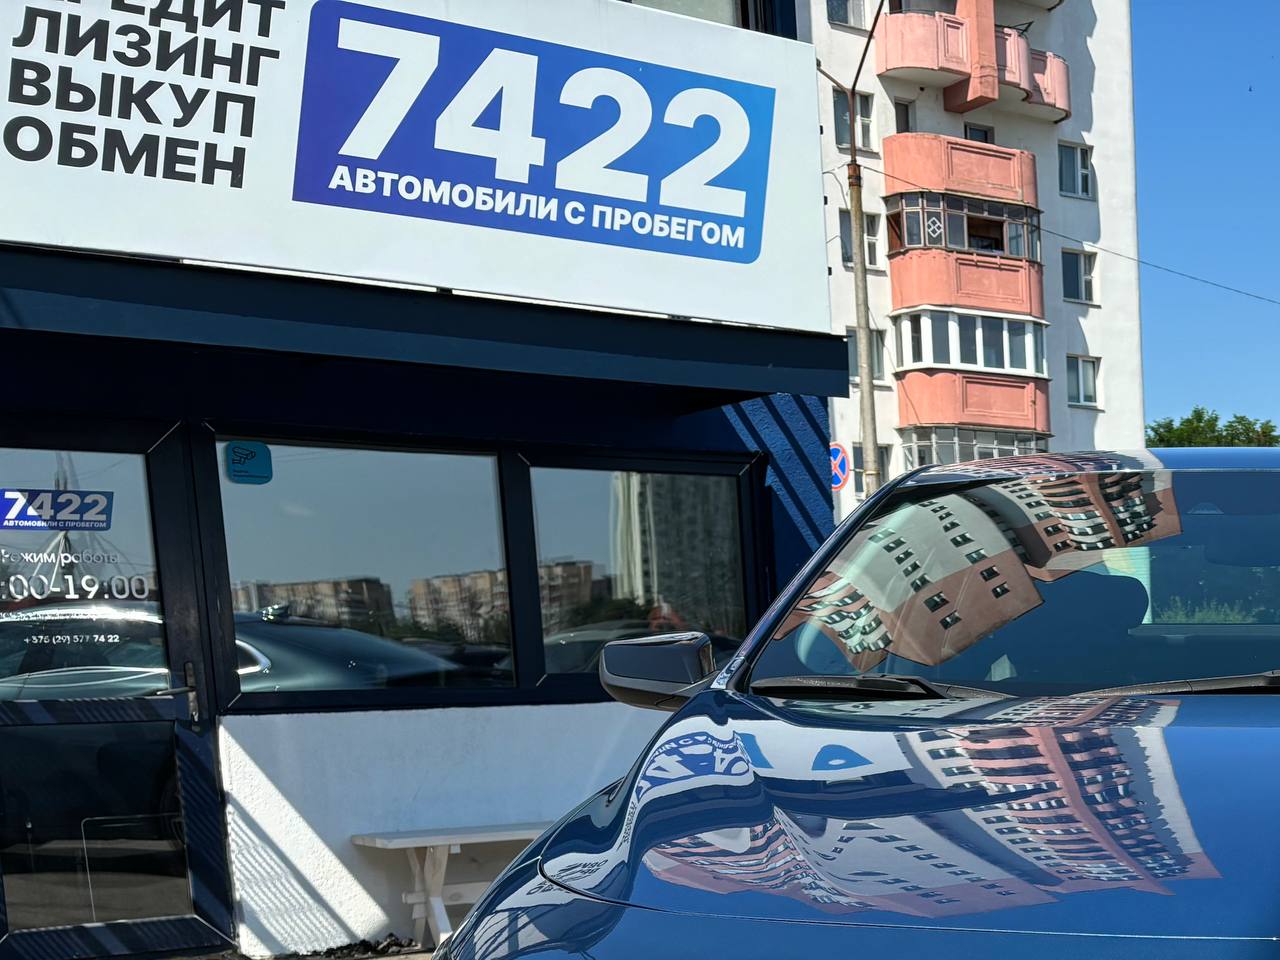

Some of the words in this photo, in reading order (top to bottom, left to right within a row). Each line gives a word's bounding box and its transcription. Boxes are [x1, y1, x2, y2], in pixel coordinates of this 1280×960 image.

[12, 6, 280, 87] ЛИЗИНГ
[55, 0, 286, 38] ДИТ
[8, 57, 256, 138] ВЫКУП
[337, 17, 751, 218] 7422
[3, 115, 246, 189] ОБМЕН
[328, 165, 558, 222] АВТОМОБИЛИ
[564, 200, 587, 225] С
[592, 204, 745, 249] ПРОБЕГОМ
[4, 491, 108, 521] 7422
